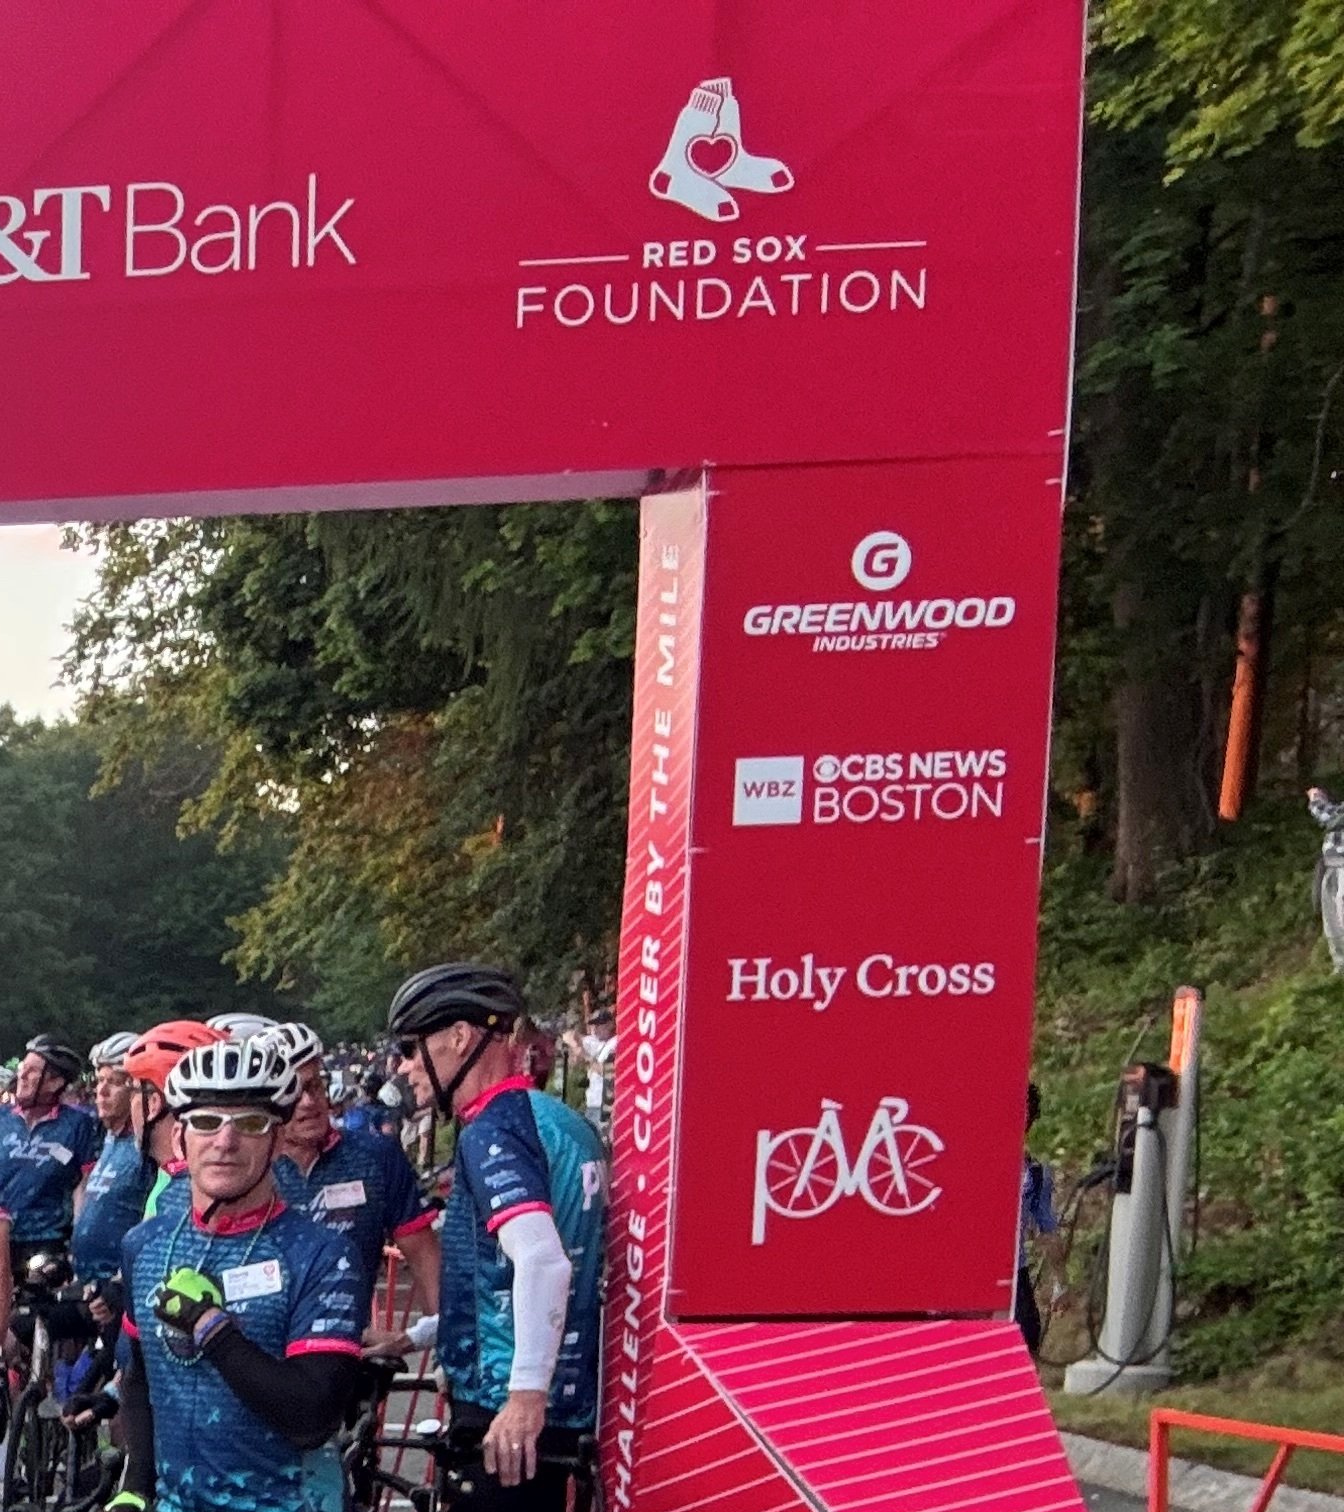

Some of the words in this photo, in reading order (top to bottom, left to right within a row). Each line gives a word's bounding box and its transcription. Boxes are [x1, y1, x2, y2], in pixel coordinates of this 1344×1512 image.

[125, 173, 356, 278] Bank
[642, 239, 716, 268] RED
[733, 235, 807, 264] SOX
[516, 268, 927, 329] FOUNDATION
[656, 543, 679, 686] MILE
[743, 597, 1016, 636] GREENWOOD
[813, 632, 940, 652] INDUSTRIES
[649, 709, 672, 823] THE
[743, 780, 796, 799] WBZ
[841, 753, 904, 781] CBS
[909, 749, 1007, 779] NEWS
[814, 782, 1003, 824] BOSTON
[643, 841, 665, 915] BY
[726, 953, 847, 1011] Holy
[857, 953, 996, 997] Cross
[633, 935, 661, 1151] CLOSER
